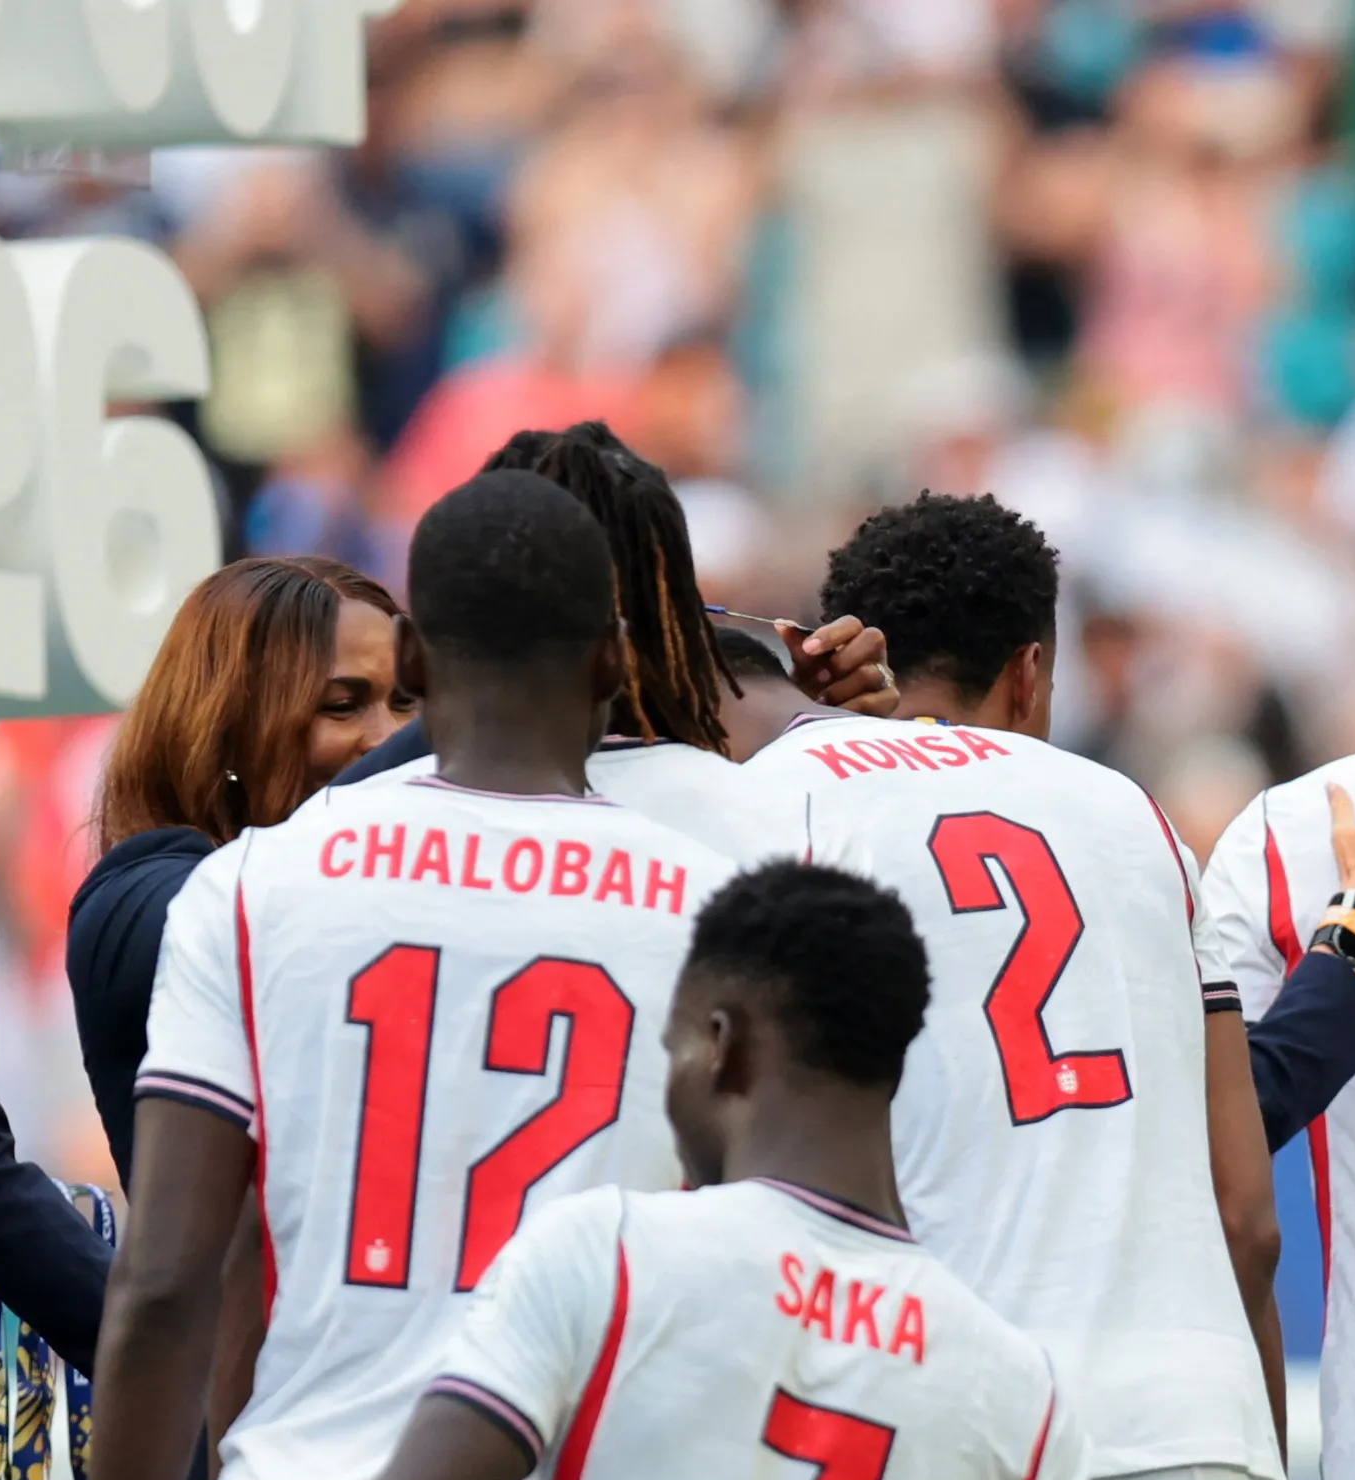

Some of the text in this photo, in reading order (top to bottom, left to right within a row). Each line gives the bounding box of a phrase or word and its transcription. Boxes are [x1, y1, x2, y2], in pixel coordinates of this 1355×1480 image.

[808, 728, 1011, 781] KONSA
[319, 823, 688, 916] CHALOBAH
[927, 809, 1132, 1126] 2
[346, 942, 635, 1293] 12
[774, 1251, 929, 1366] SAKA
